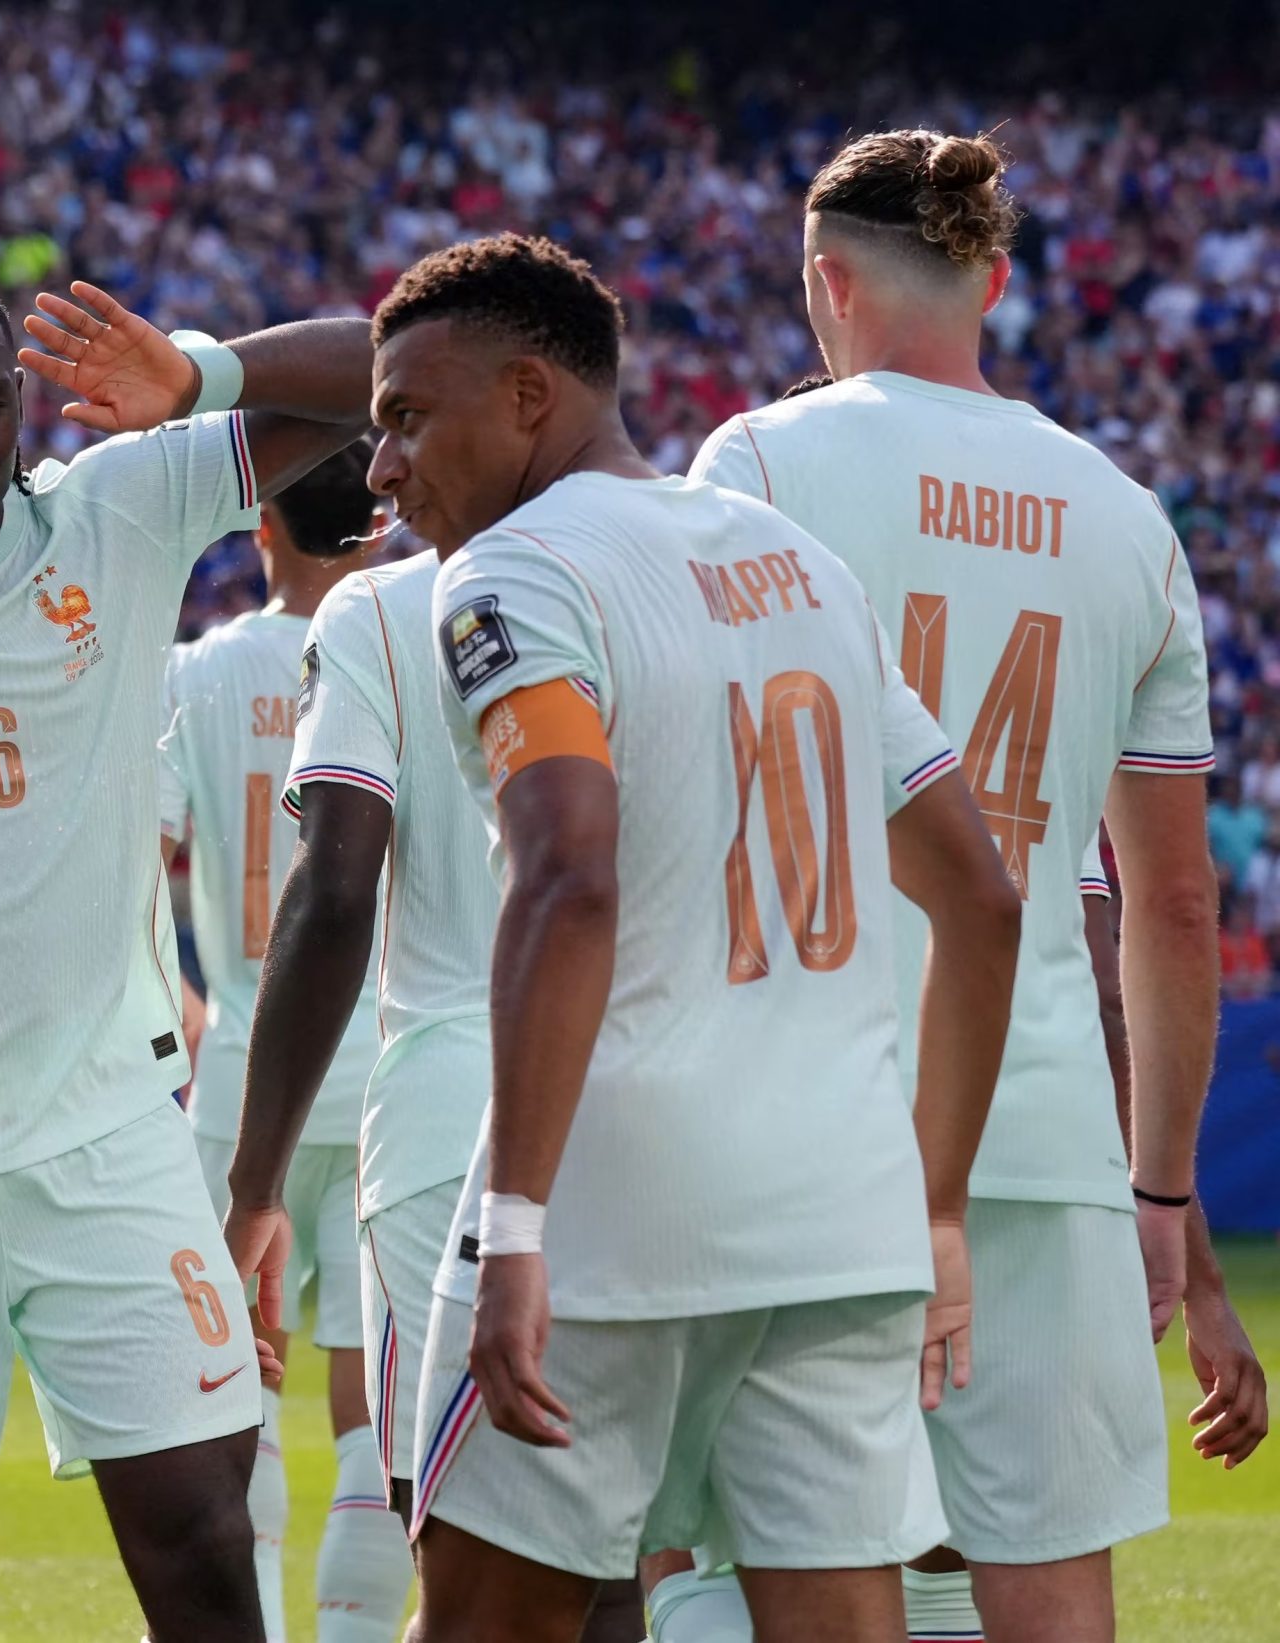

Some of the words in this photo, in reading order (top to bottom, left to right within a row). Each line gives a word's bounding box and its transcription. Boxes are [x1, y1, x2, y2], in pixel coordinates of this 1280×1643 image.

[919, 474, 1068, 558] RABIOT
[724, 670, 857, 985] 10
[171, 1248, 231, 1347] 6
